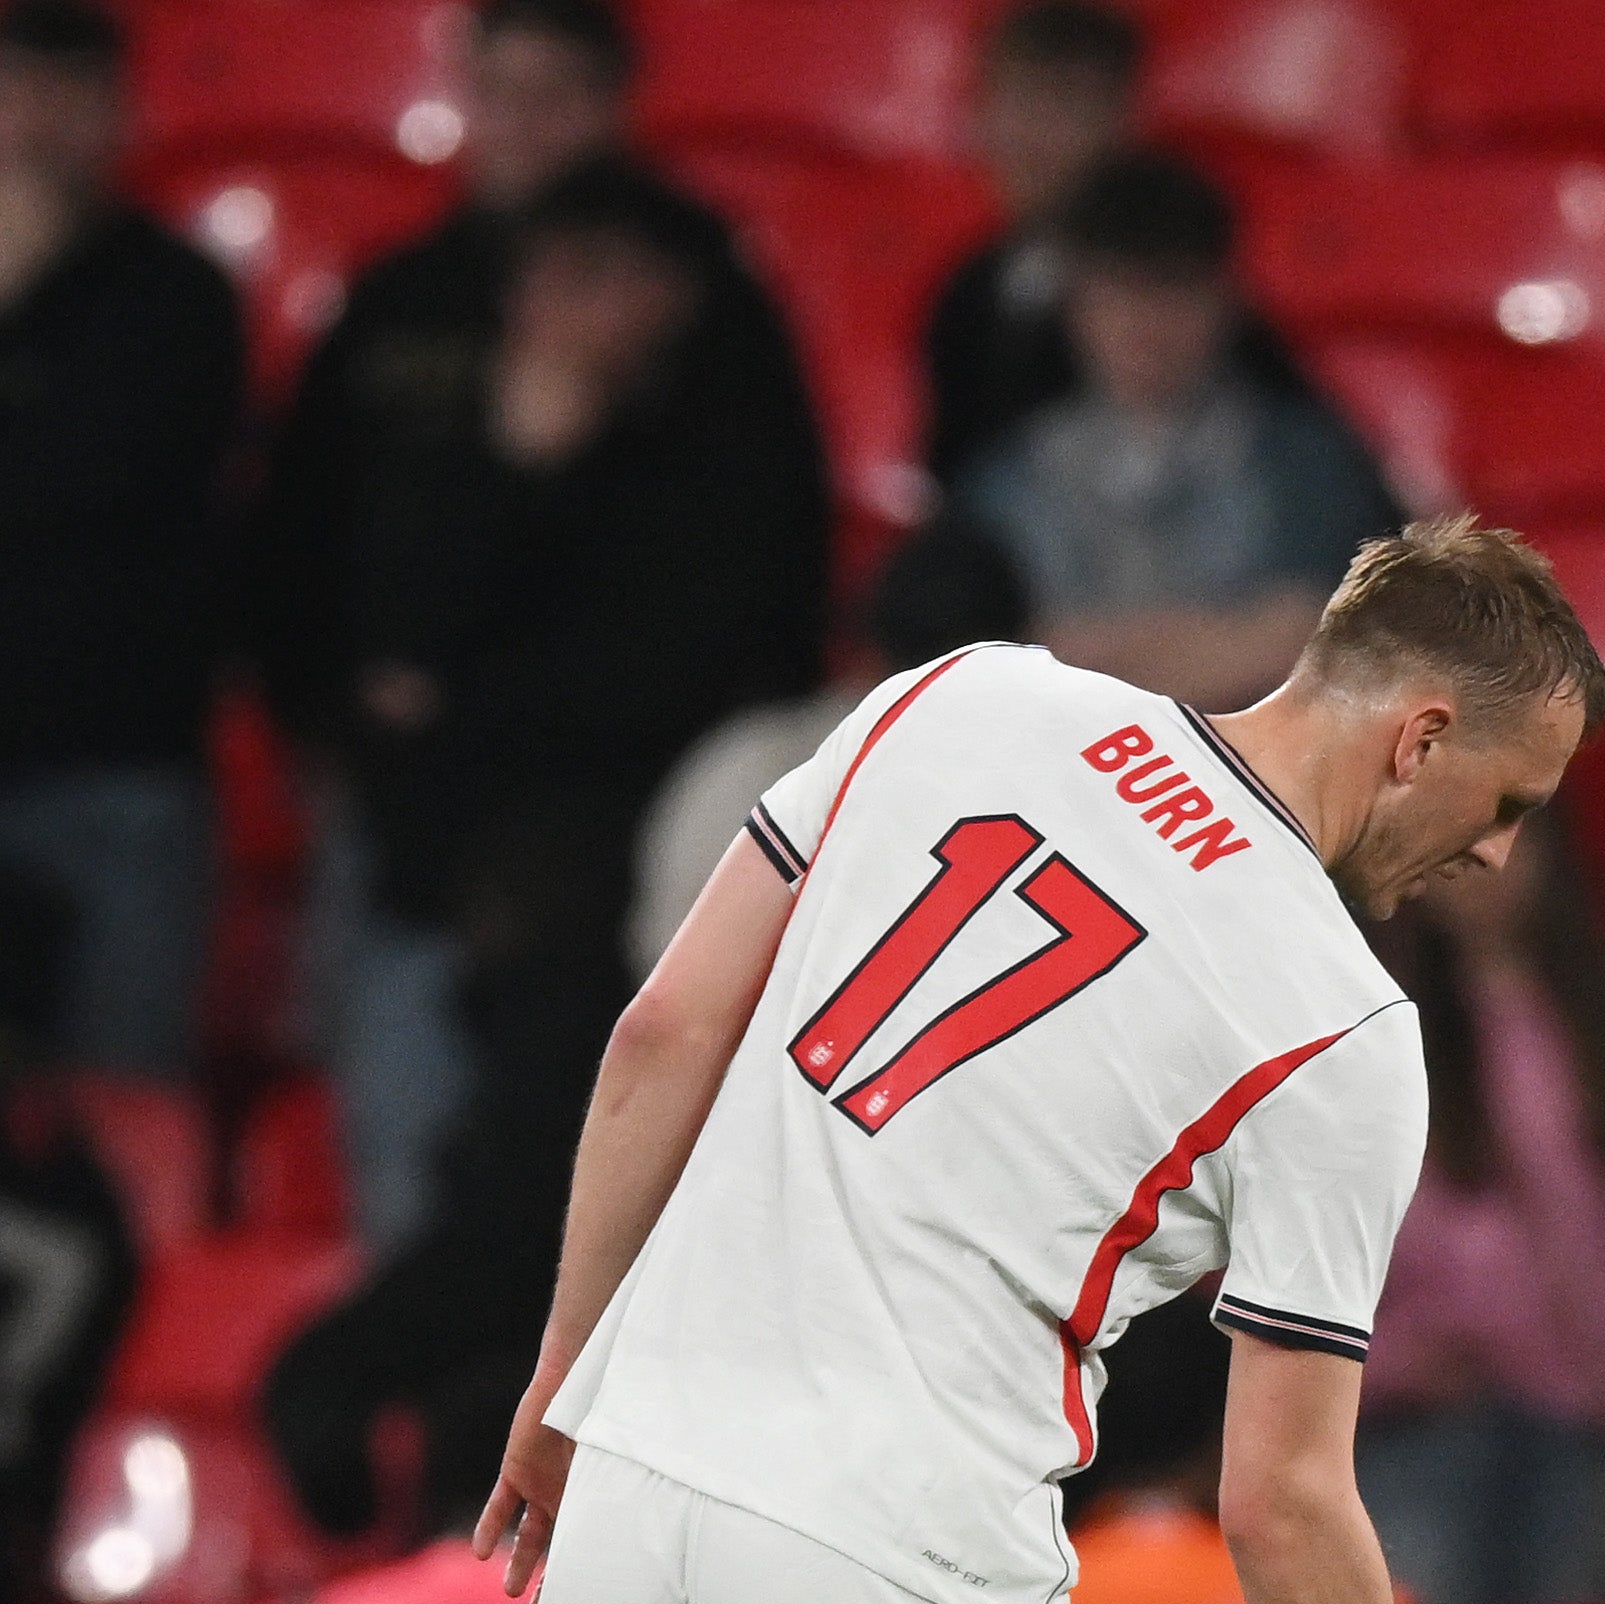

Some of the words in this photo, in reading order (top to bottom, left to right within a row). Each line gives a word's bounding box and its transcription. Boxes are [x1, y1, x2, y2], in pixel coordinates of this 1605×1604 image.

[1079, 723, 1253, 872] BURN
[785, 813, 1149, 1137] 17
[921, 1549, 991, 1588] AERO-FIT
